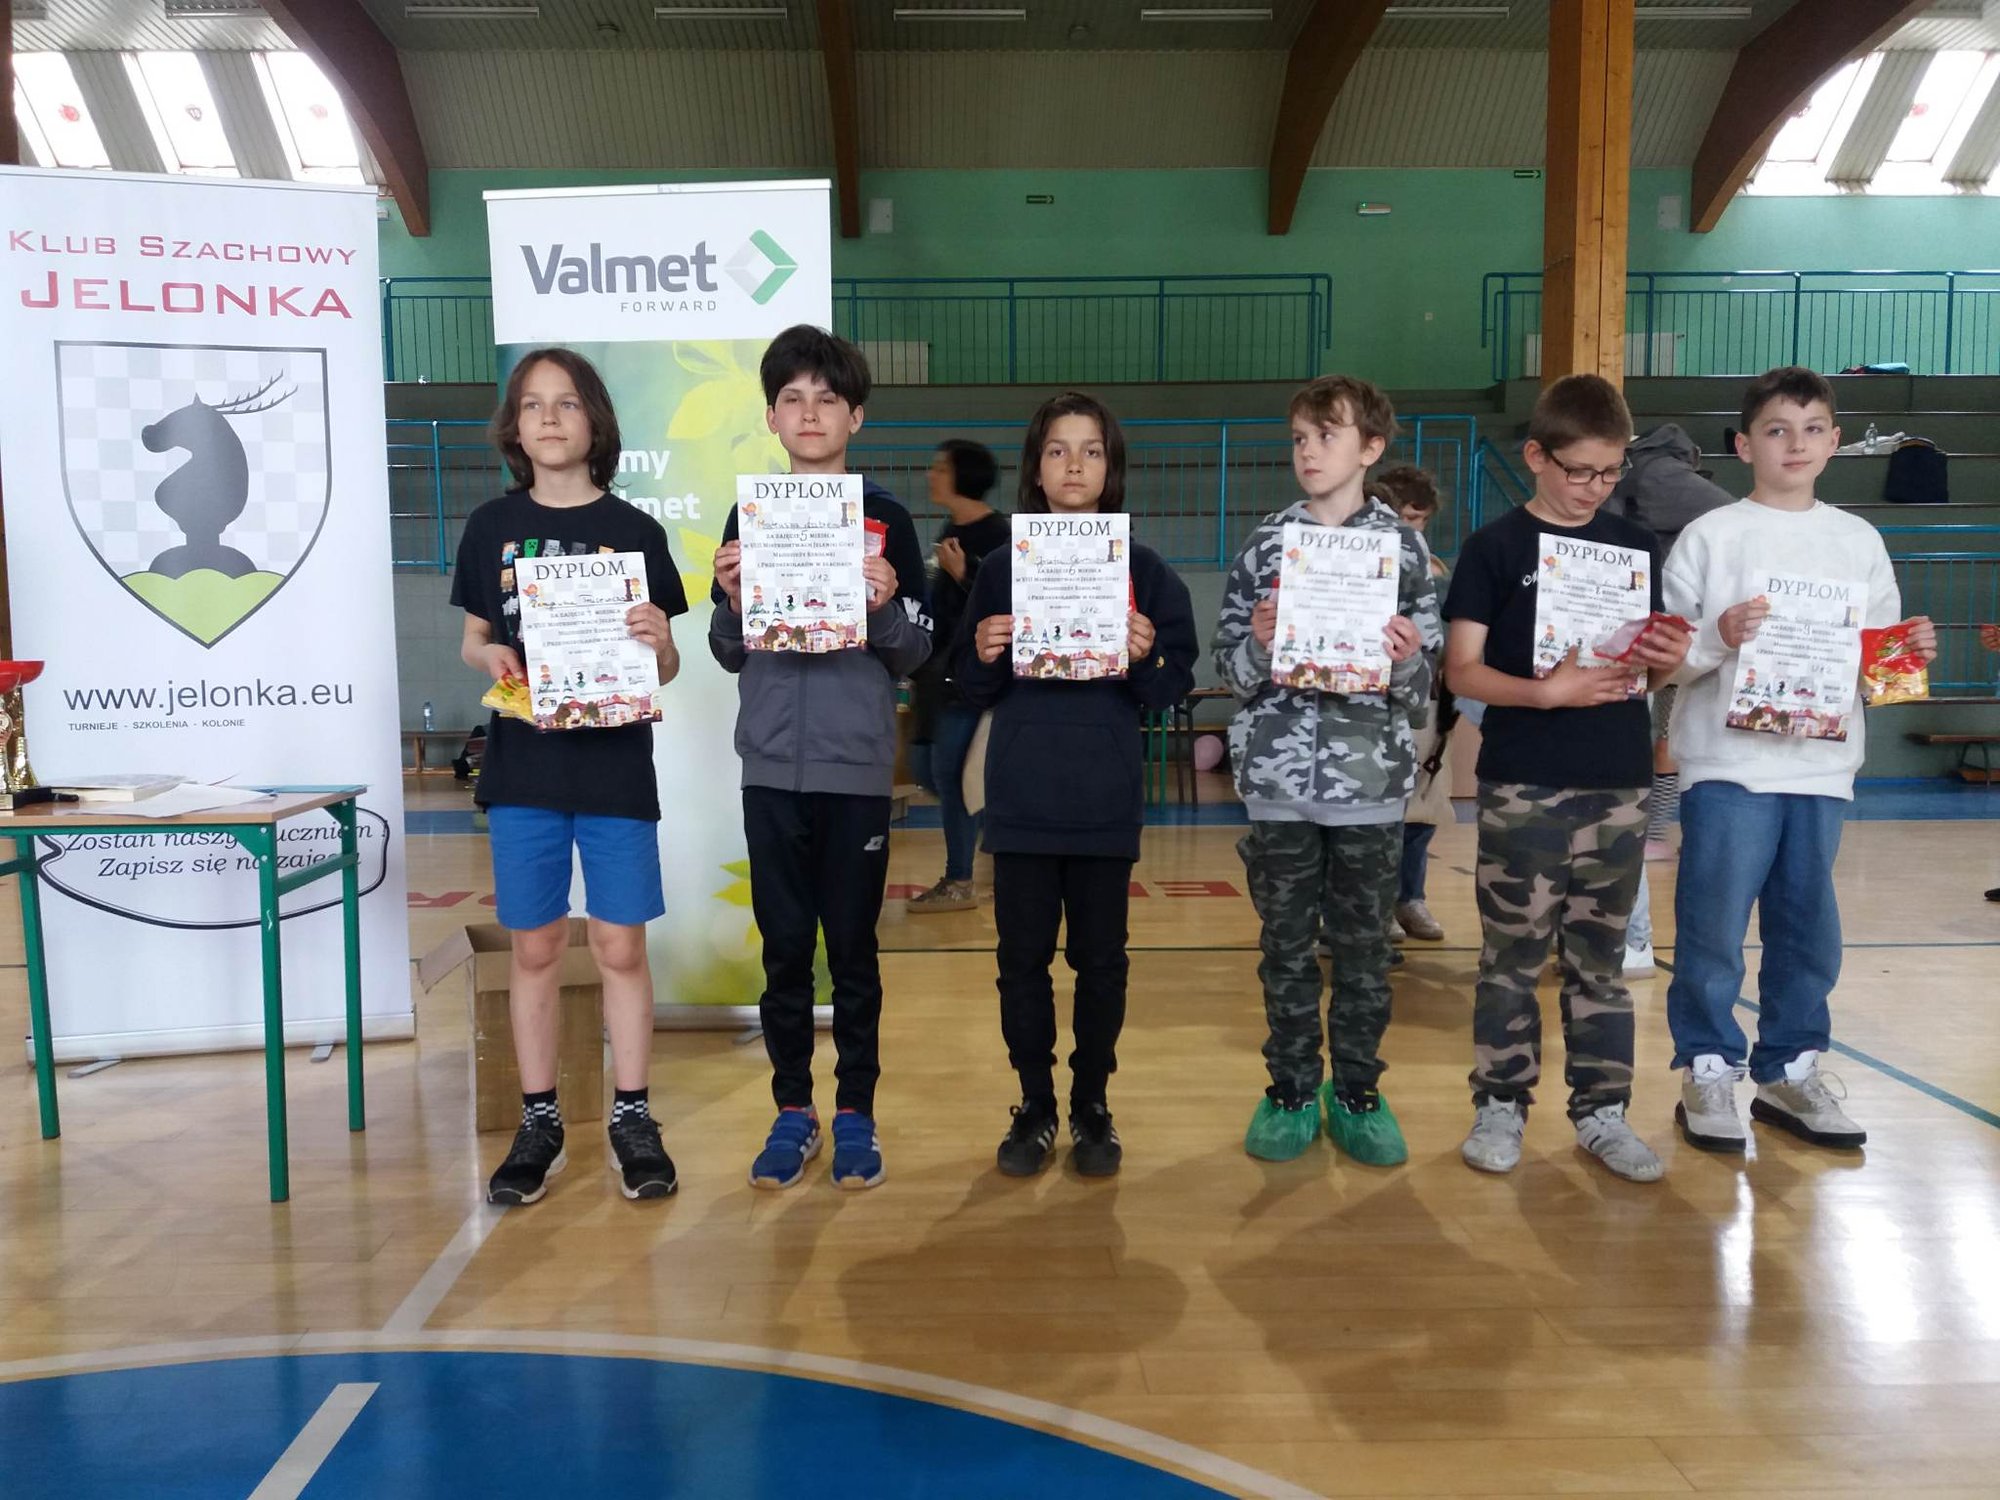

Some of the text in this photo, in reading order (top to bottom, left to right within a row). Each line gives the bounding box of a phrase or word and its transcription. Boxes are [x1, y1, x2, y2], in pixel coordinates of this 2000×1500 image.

[9, 229, 358, 265] KLUB SZACHOWY
[520, 240, 718, 295] Valmet
[20, 271, 353, 319] JELONKA
[620, 300, 717, 313] FORWARD
[755, 482, 844, 499] DYPLOM
[1029, 520, 1111, 537] DYPLOM
[1300, 531, 1382, 552] DYPLOM
[1555, 541, 1633, 567] DYPLOM
[535, 560, 626, 580] DYPLOM
[1767, 577, 1849, 602] DYPLOM
[63, 678, 353, 716] www.jelonka.eu
[69, 722, 118, 731] TURNIEJE
[133, 720, 189, 730] SZKOLENIA
[201, 719, 246, 728] KOLONIE
[164, 832, 238, 850] naszy
[98, 856, 184, 880] Zapisz
[192, 853, 227, 875] się
